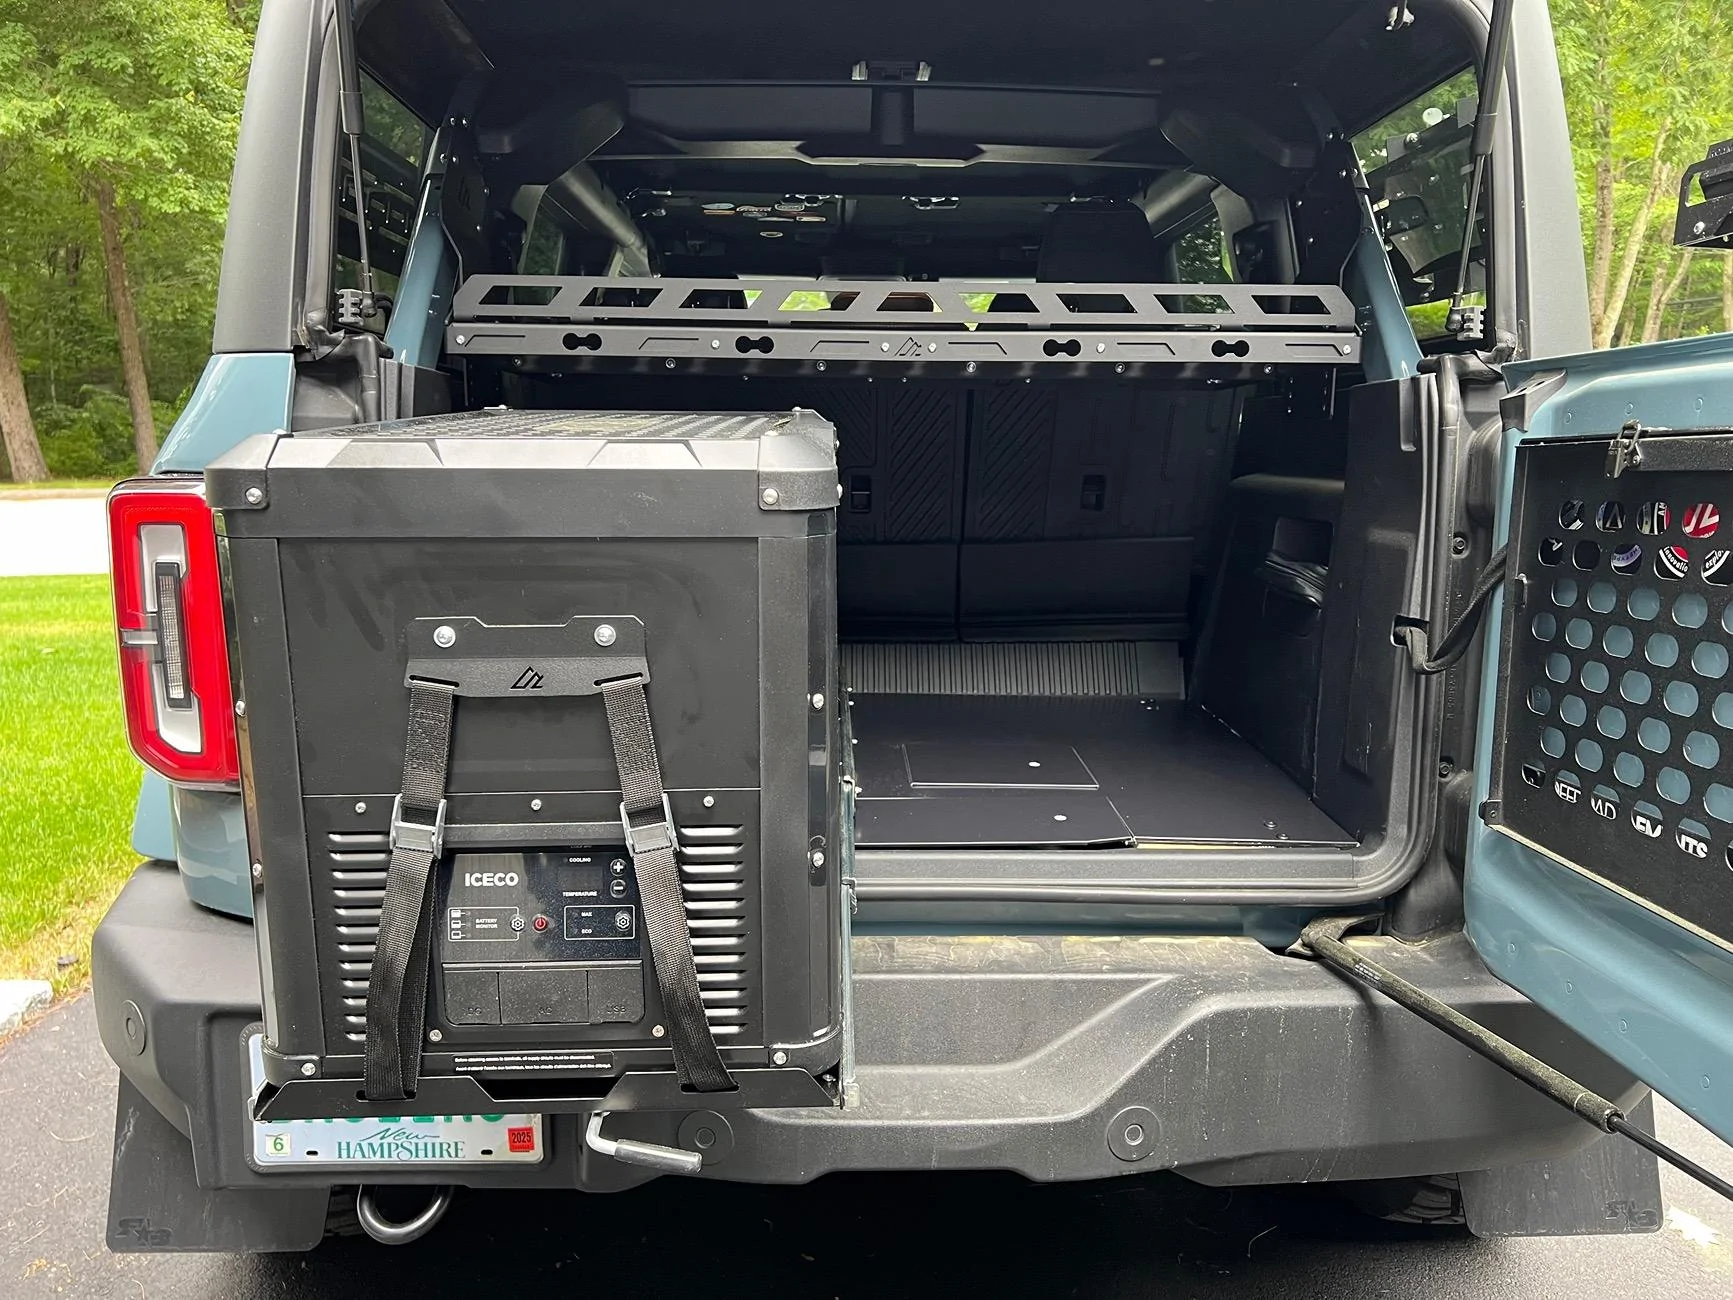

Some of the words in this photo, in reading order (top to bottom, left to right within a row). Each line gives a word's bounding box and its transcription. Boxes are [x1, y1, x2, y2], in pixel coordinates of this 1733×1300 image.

[1663, 546, 1689, 572] innovatio
[1705, 550, 1724, 569] explo
[464, 872, 519, 887] ICECO
[360, 1127, 440, 1141] New
[511, 1131, 532, 1144] 2025
[273, 1137, 284, 1152] 6
[337, 1140, 466, 1161] HAMPSHIRE
